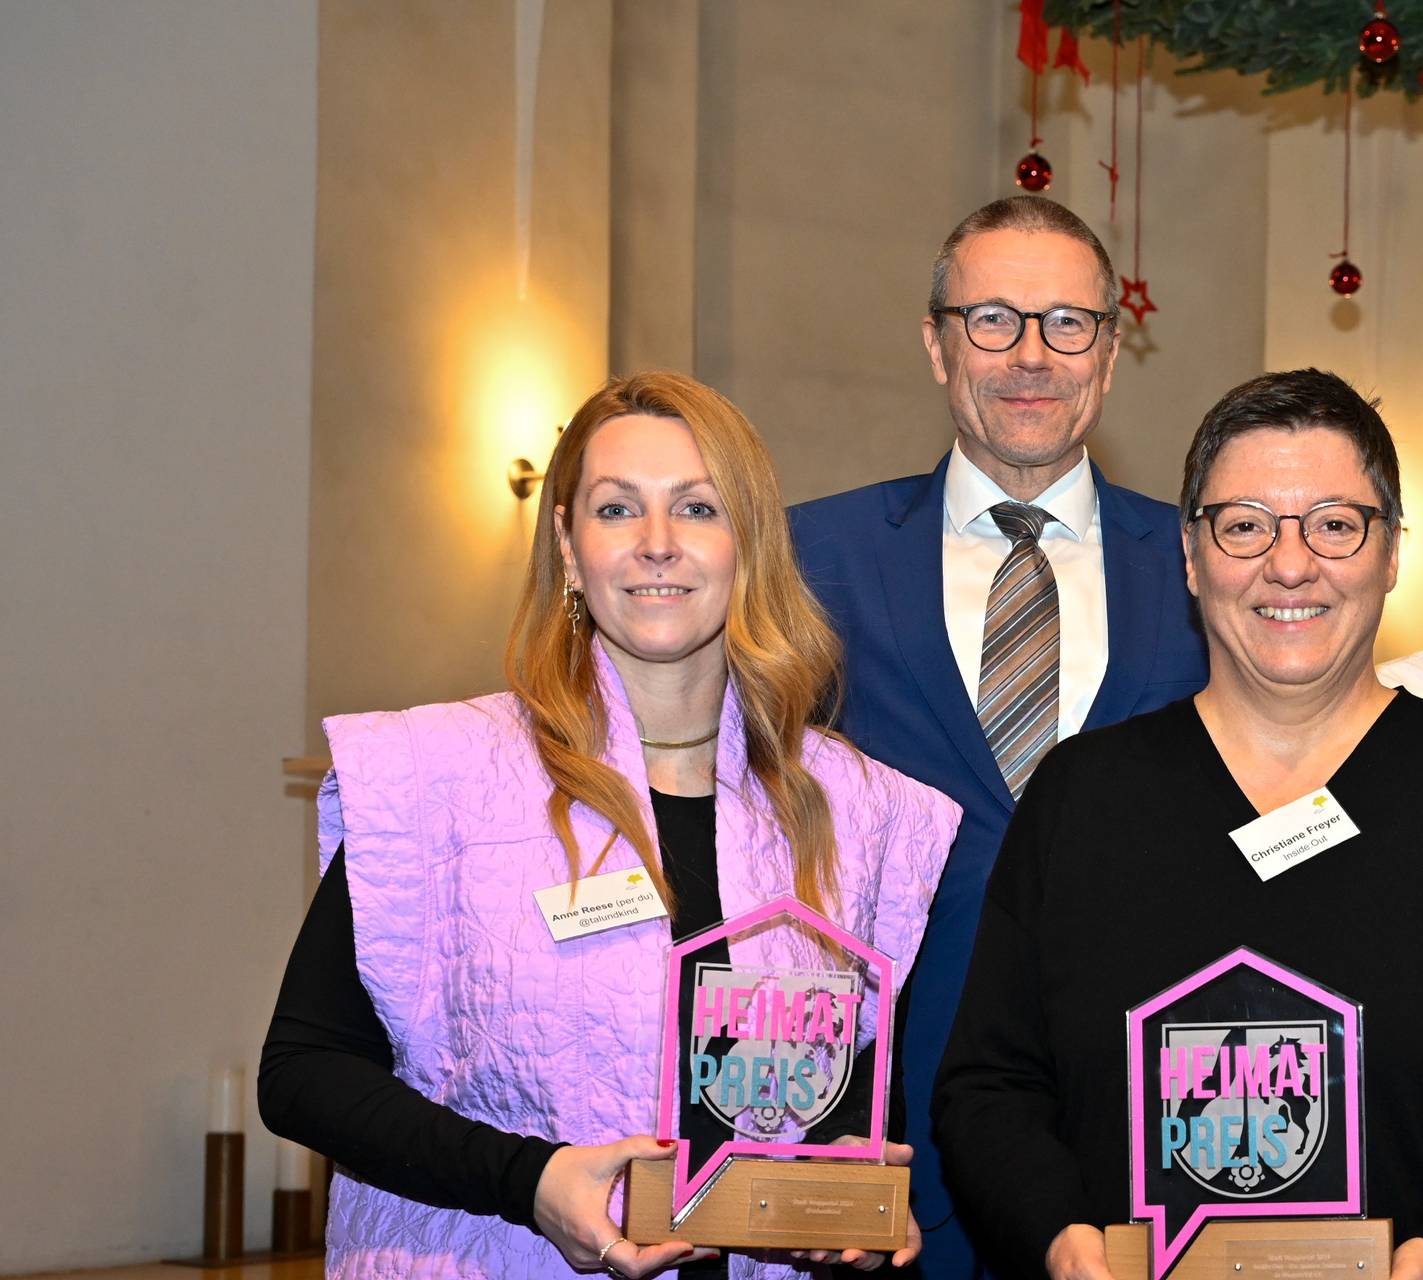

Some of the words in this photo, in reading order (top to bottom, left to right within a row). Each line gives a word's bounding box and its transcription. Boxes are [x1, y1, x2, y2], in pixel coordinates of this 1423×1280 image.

[1251, 832, 1306, 862] Christiane
[1306, 814, 1341, 835] Freyer
[1283, 843, 1310, 861] Inside
[1311, 835, 1328, 848] Out
[552, 910, 579, 922] Anne
[582, 901, 614, 914] Reese
[616, 896, 635, 908] (per
[637, 892, 654, 902] du)
[579, 907, 639, 928] @talundkind
[694, 985, 862, 1044] HEIMAT
[690, 1053, 817, 1110] PREIS
[1160, 1043, 1328, 1100] HEIMAT
[1161, 1114, 1288, 1169] PREIS
